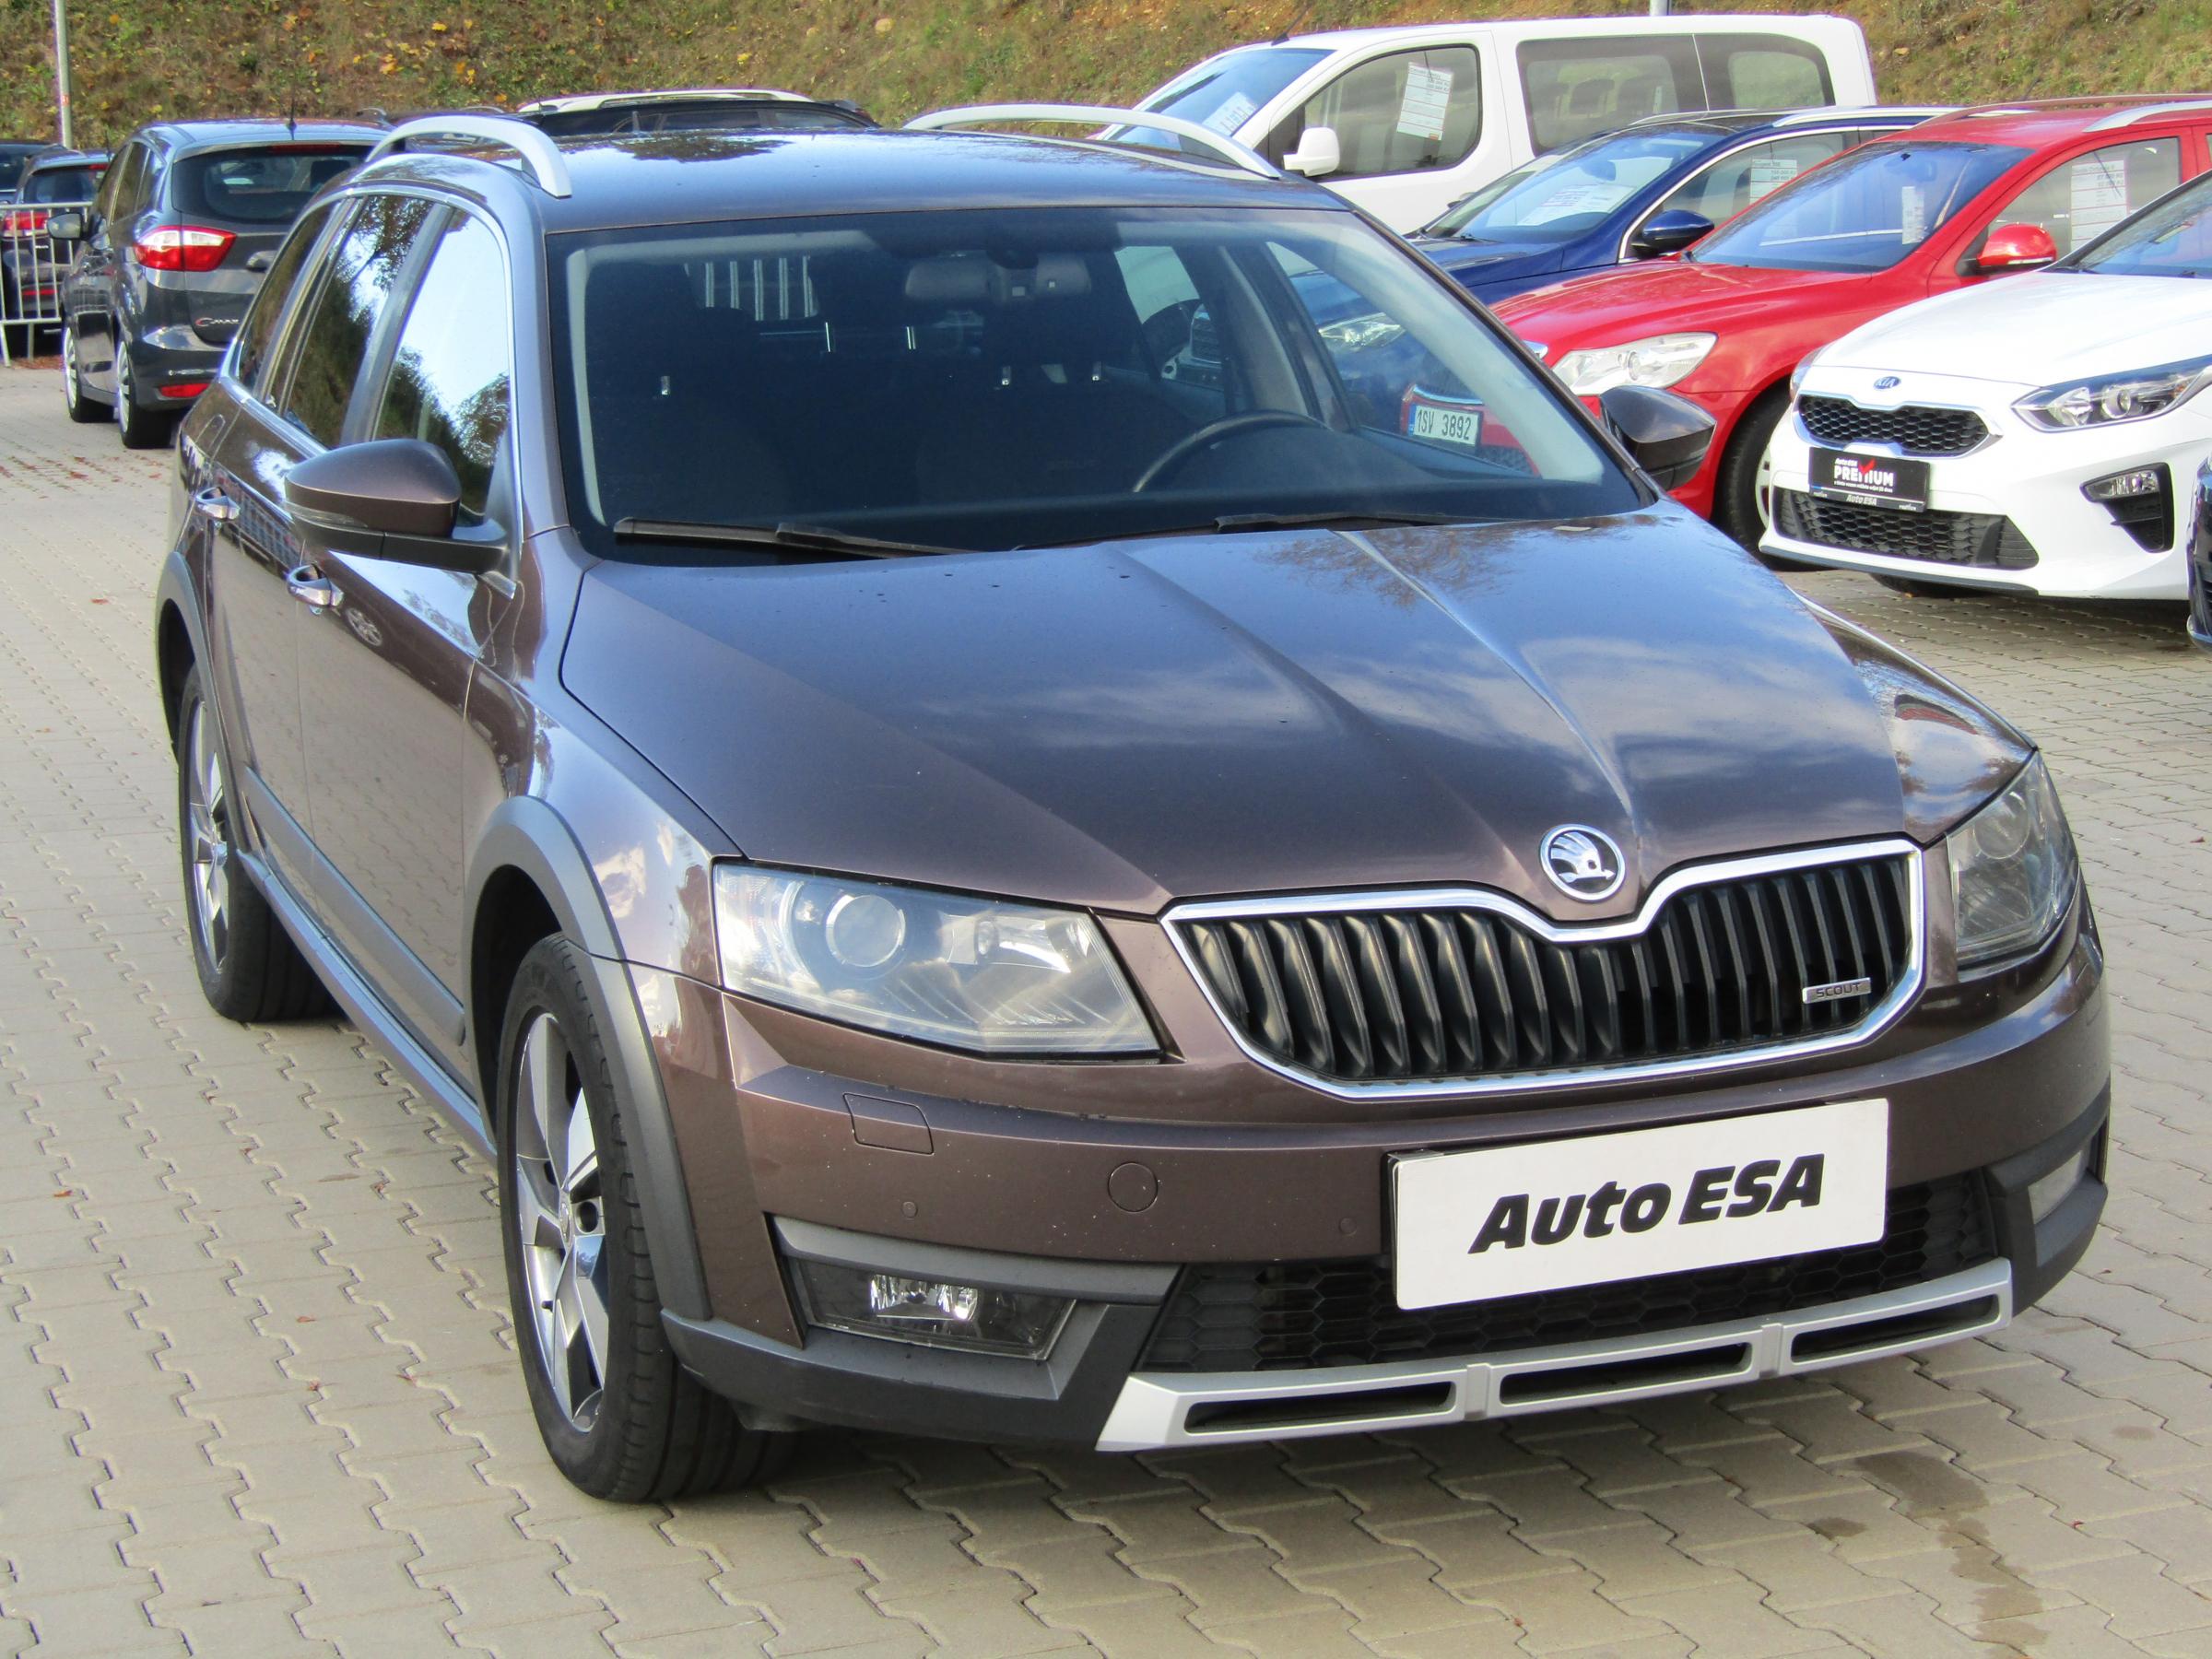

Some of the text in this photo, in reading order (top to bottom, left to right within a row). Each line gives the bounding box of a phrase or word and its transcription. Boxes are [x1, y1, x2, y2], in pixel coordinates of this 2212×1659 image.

[1417, 409, 1472, 441] 1SV 3892
[1834, 465, 1894, 488] PREMIUM
[1846, 494, 1864, 503] Auto
[1816, 982, 1860, 997] SCOUT
[1467, 1153, 1825, 1254] Auto ESA
